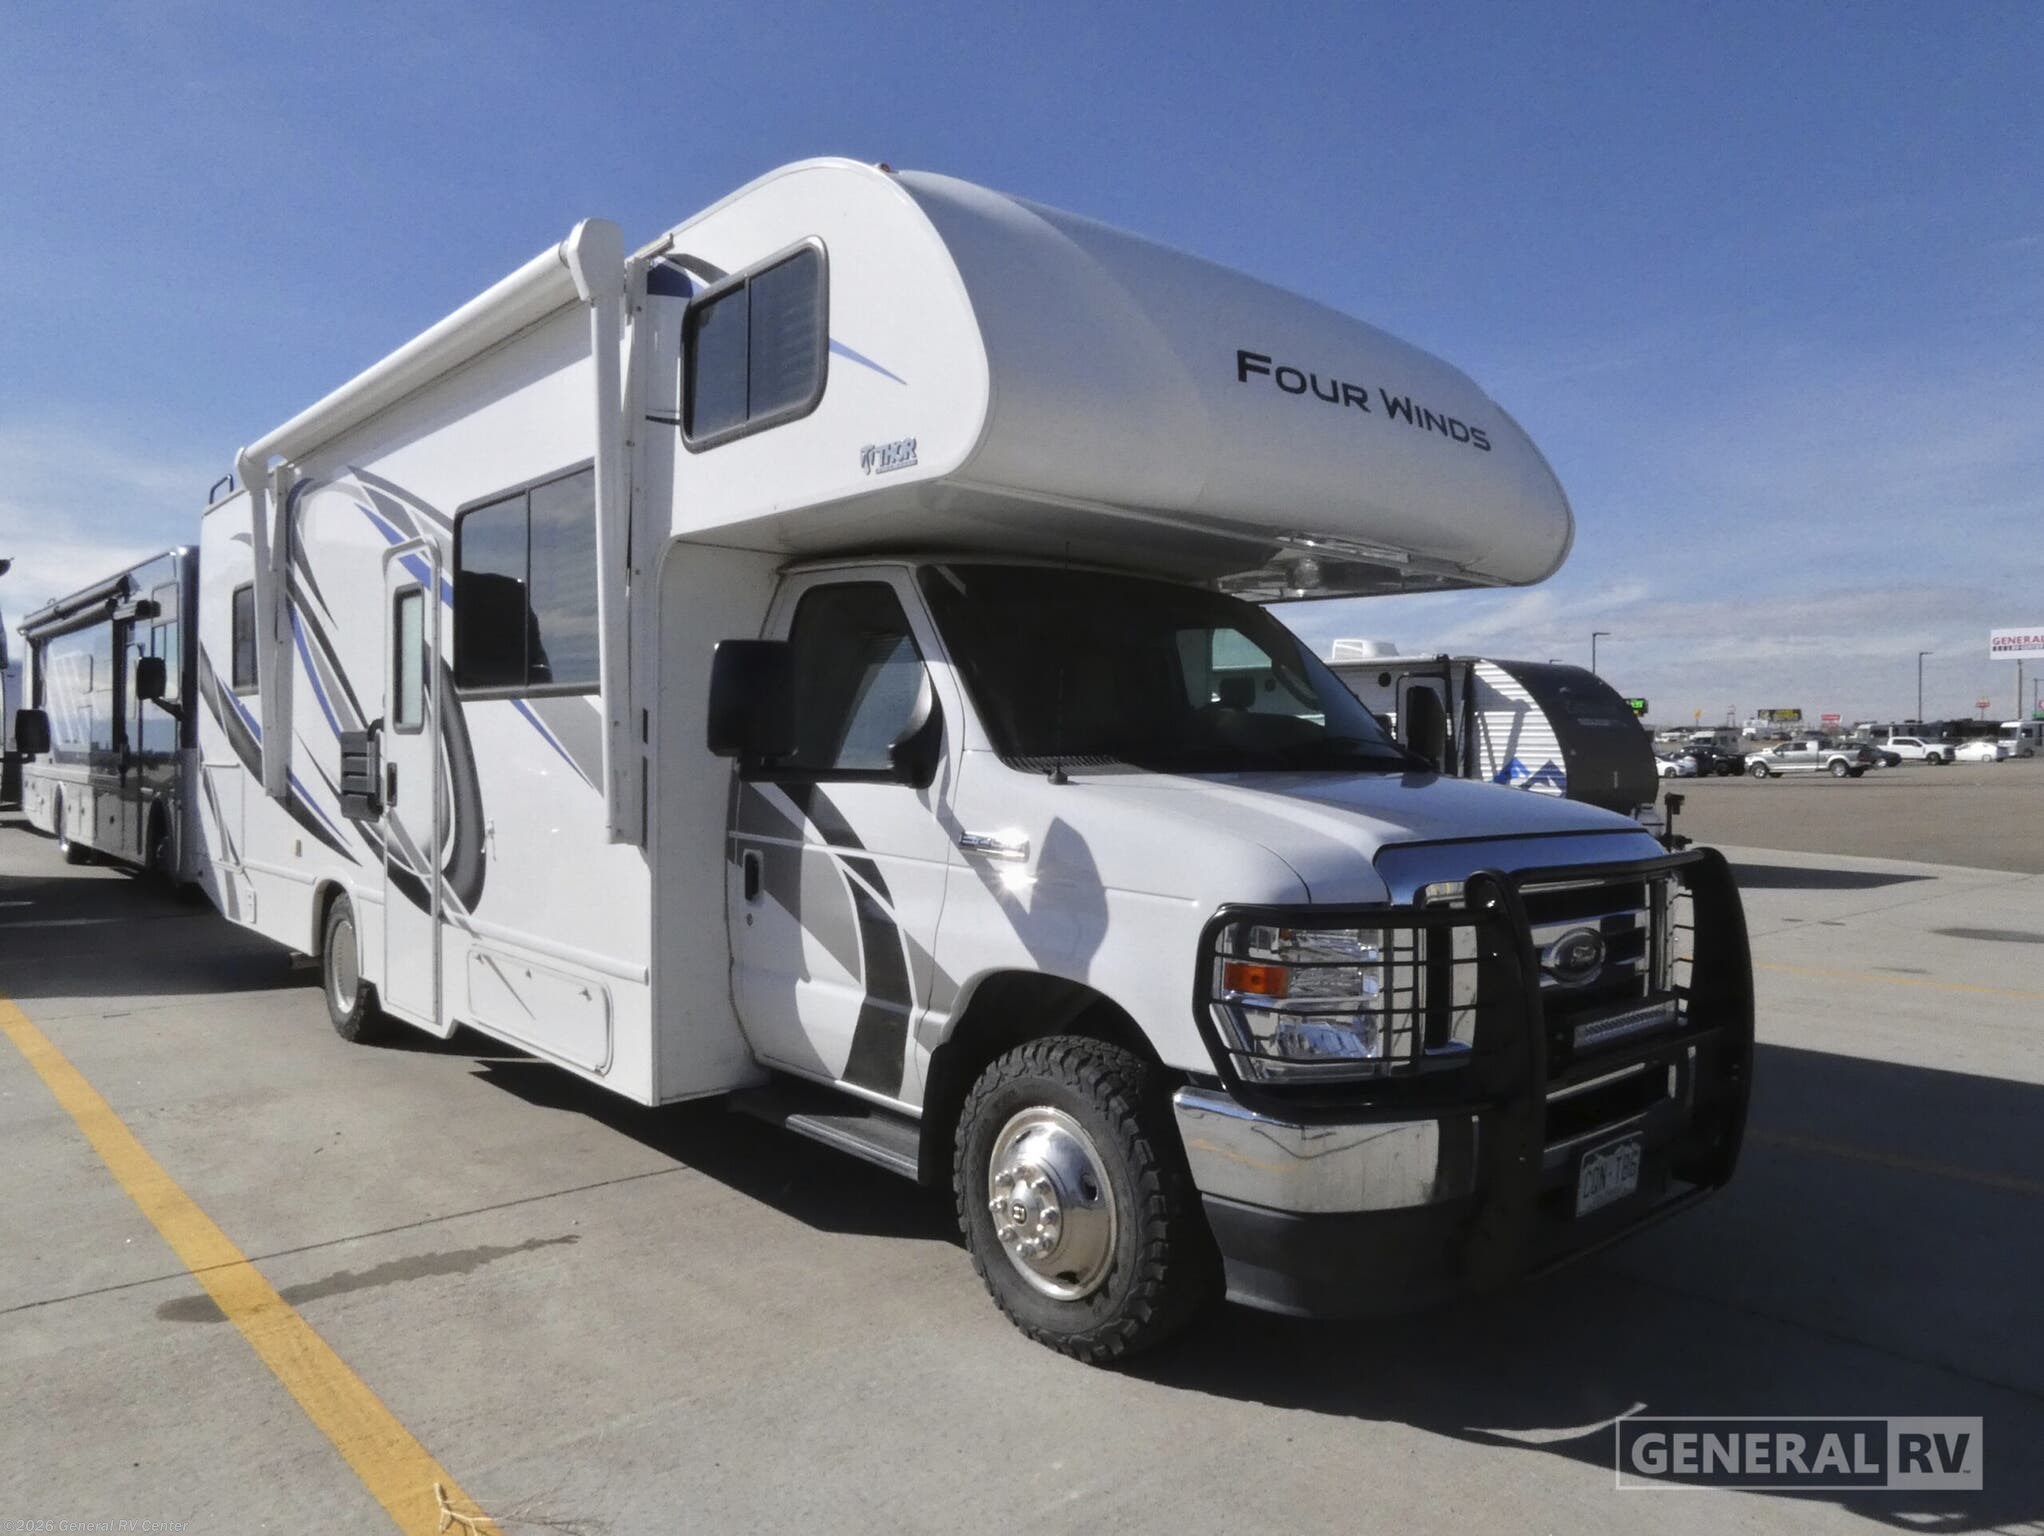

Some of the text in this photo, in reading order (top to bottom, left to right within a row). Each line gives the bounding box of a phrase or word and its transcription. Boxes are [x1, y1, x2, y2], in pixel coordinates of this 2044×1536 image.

[1237, 350, 1491, 452] FOUR WINDS
[876, 437, 917, 467] THOR
